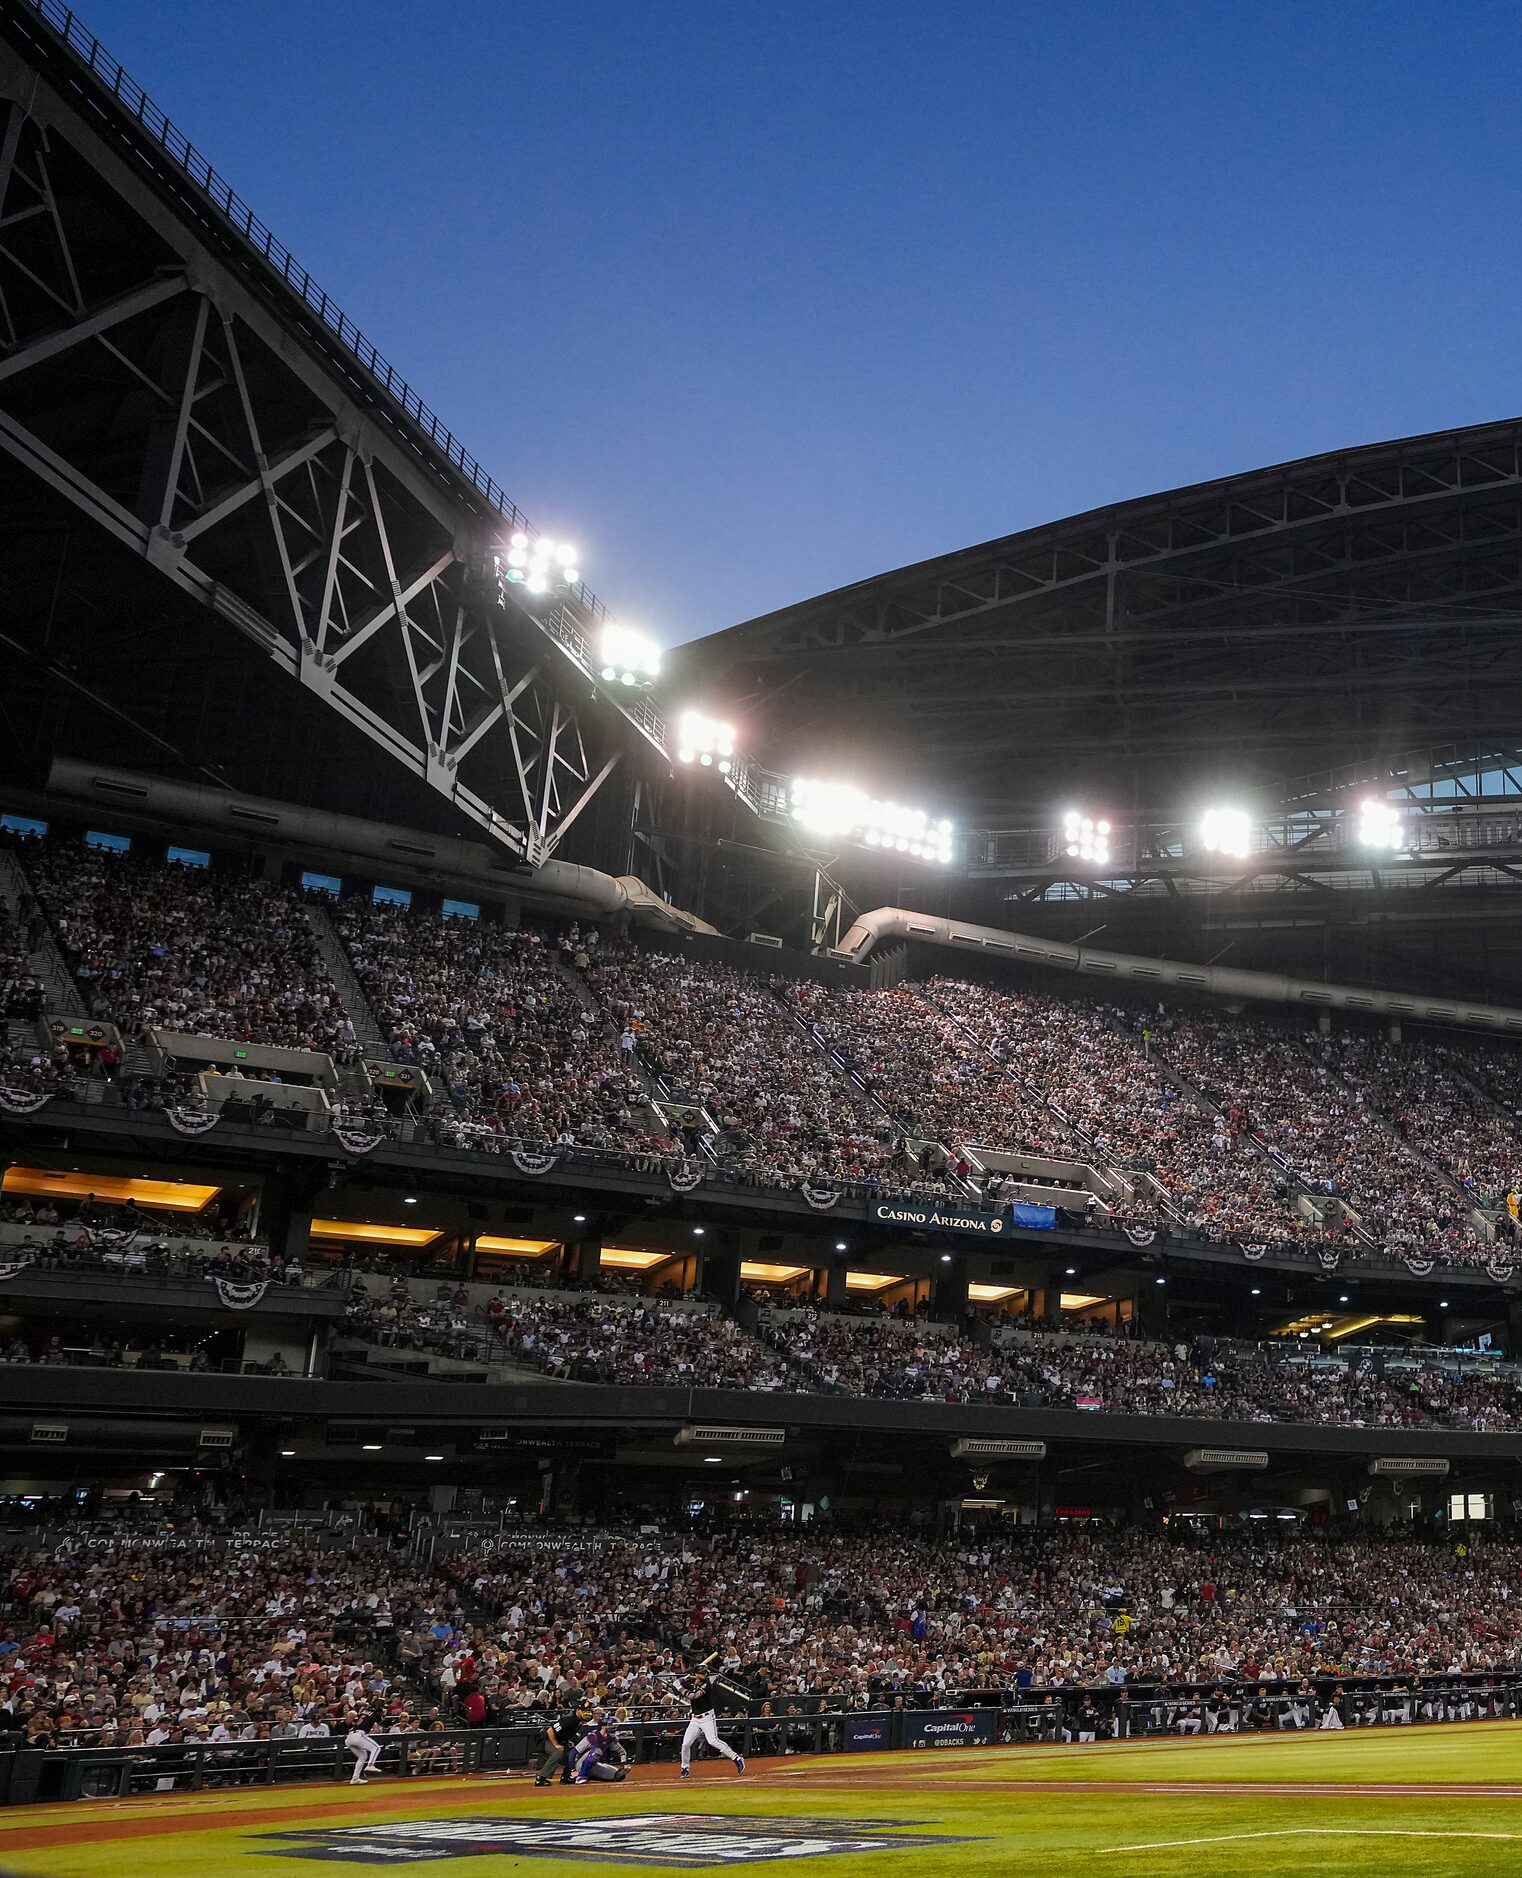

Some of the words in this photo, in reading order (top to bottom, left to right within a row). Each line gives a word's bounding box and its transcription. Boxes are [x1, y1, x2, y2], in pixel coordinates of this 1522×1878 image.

[877, 1206, 926, 1223] CASINO
[929, 1212, 987, 1231] ARIZONA
[934, 1738, 964, 1747] @DBACKS
